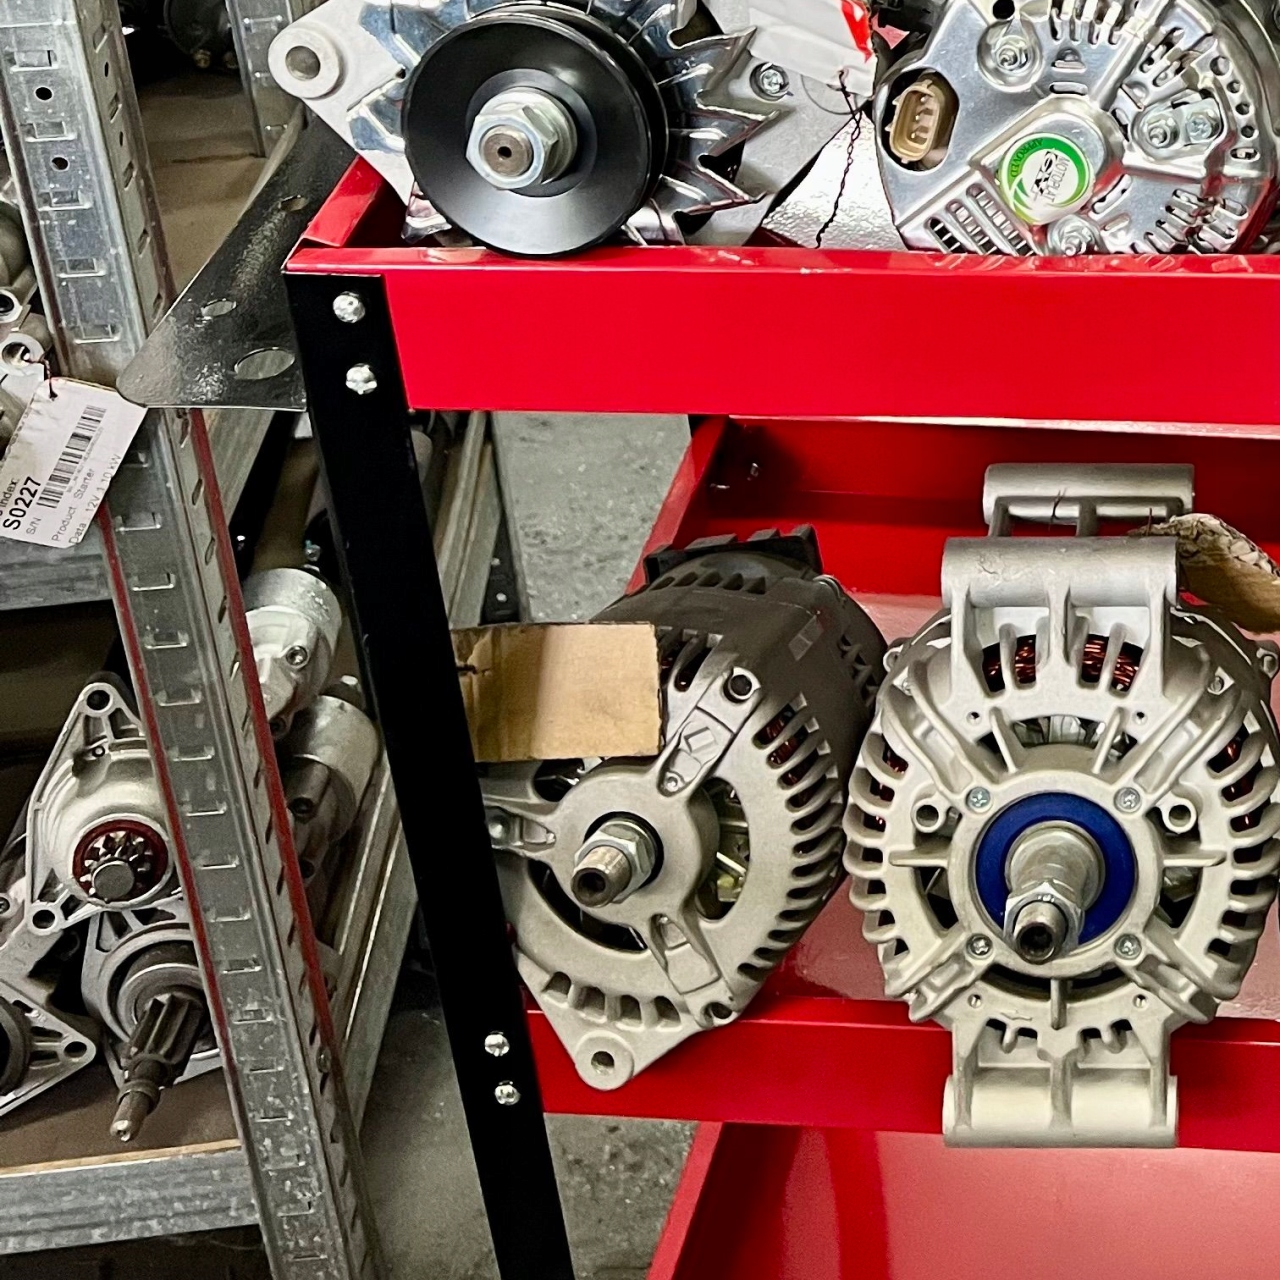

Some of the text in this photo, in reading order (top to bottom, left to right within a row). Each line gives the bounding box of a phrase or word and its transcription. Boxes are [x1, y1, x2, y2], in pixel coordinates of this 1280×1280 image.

[1010, 138, 1044, 178] APPROVED
[1043, 156, 1070, 203] MOTOPLAT
[2, 476, 41, 530] S0227
[85, 495, 101, 512] 12V
